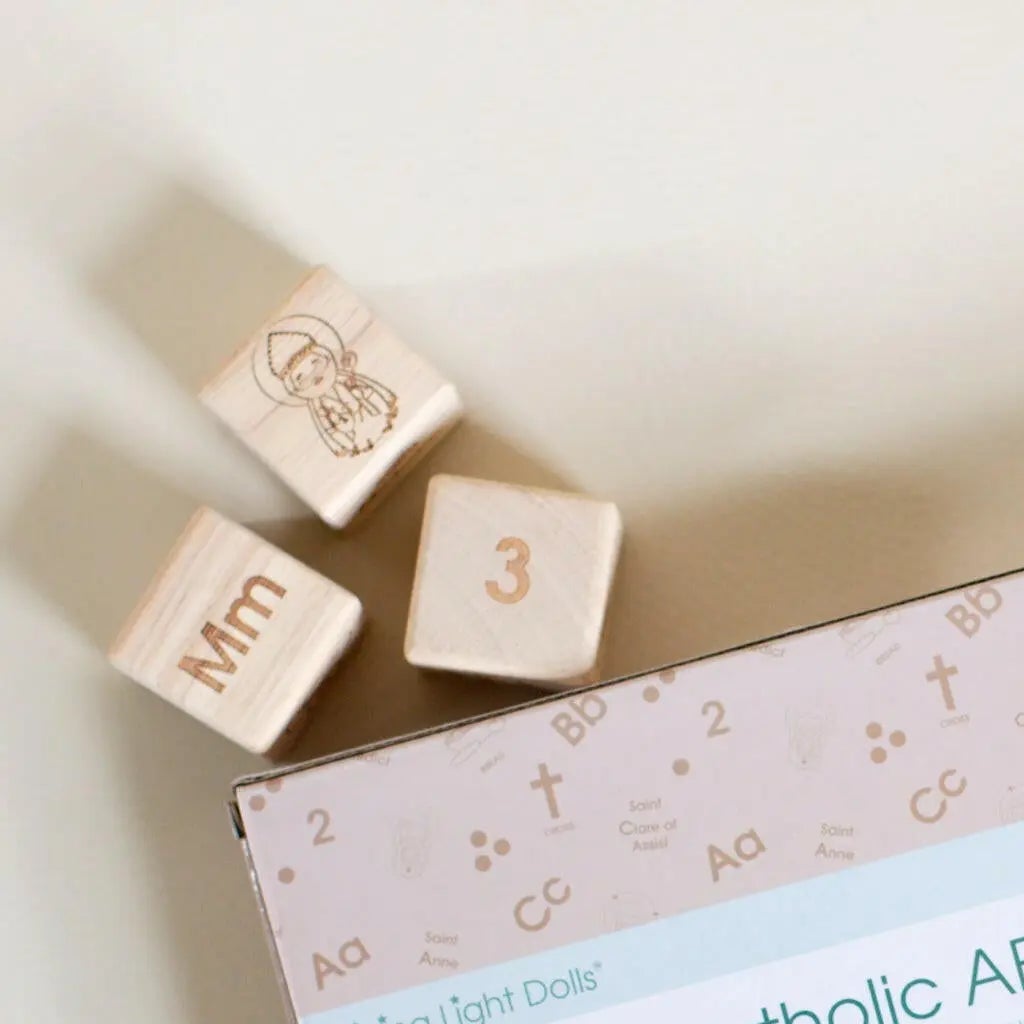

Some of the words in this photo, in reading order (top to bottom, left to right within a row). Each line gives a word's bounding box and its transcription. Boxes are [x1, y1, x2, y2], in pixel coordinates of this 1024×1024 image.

[484, 536, 531, 604] 3
[177, 574, 287, 695] Mm
[945, 585, 1003, 639] Bb
[551, 694, 608, 746] Bb
[701, 700, 731, 738] 2
[628, 798, 662, 812] Saint
[909, 769, 967, 823] Cc
[307, 808, 336, 846] 2
[663, 819, 677, 832] of
[820, 823, 854, 837] Saint
[706, 828, 767, 883] Aa
[815, 842, 855, 861] Anne
[513, 877, 571, 932] Cc
[418, 951, 459, 969] Anne
[425, 931, 458, 945] Saint
[312, 937, 371, 991] Aa
